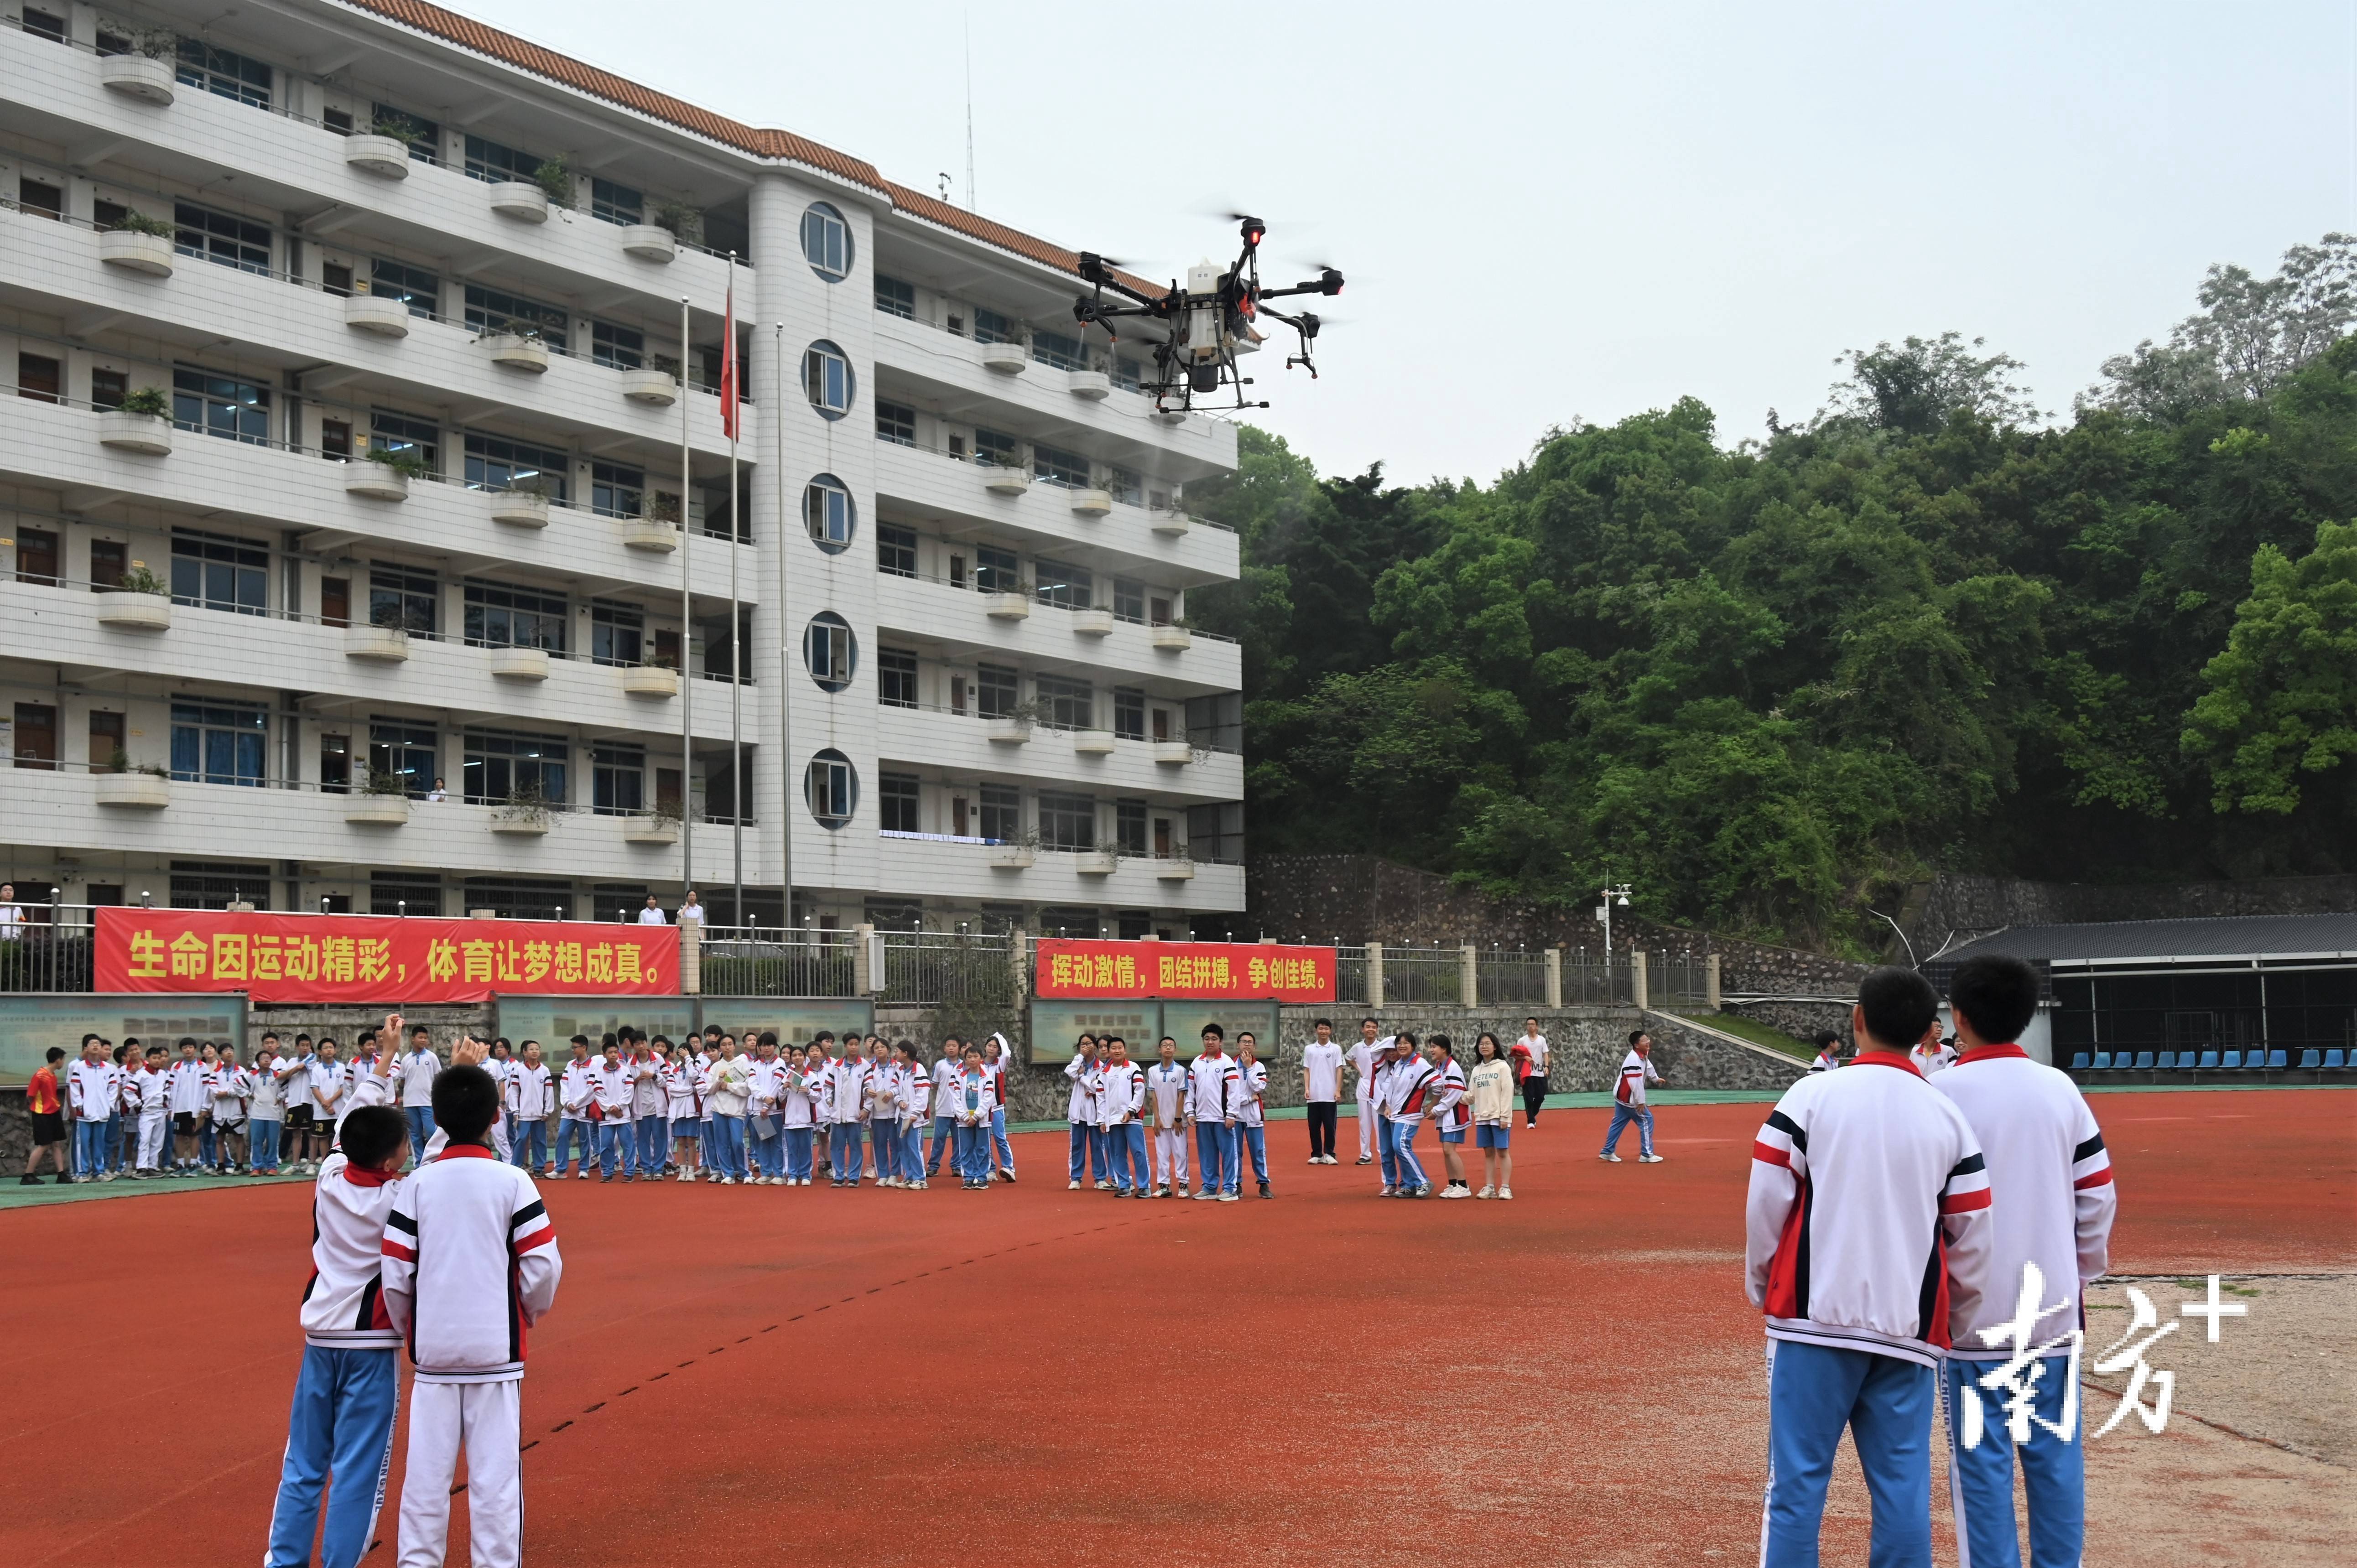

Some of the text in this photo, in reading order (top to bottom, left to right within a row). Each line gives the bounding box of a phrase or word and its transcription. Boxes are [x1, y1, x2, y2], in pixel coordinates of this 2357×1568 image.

[128, 929, 658, 984] 生命因运动精彩，体育让梦想成真。
[1051, 953, 1325, 990] 挥动激情，团结拼搏，争创佳绩。
[1473, 1073, 1498, 1084] PETEND
